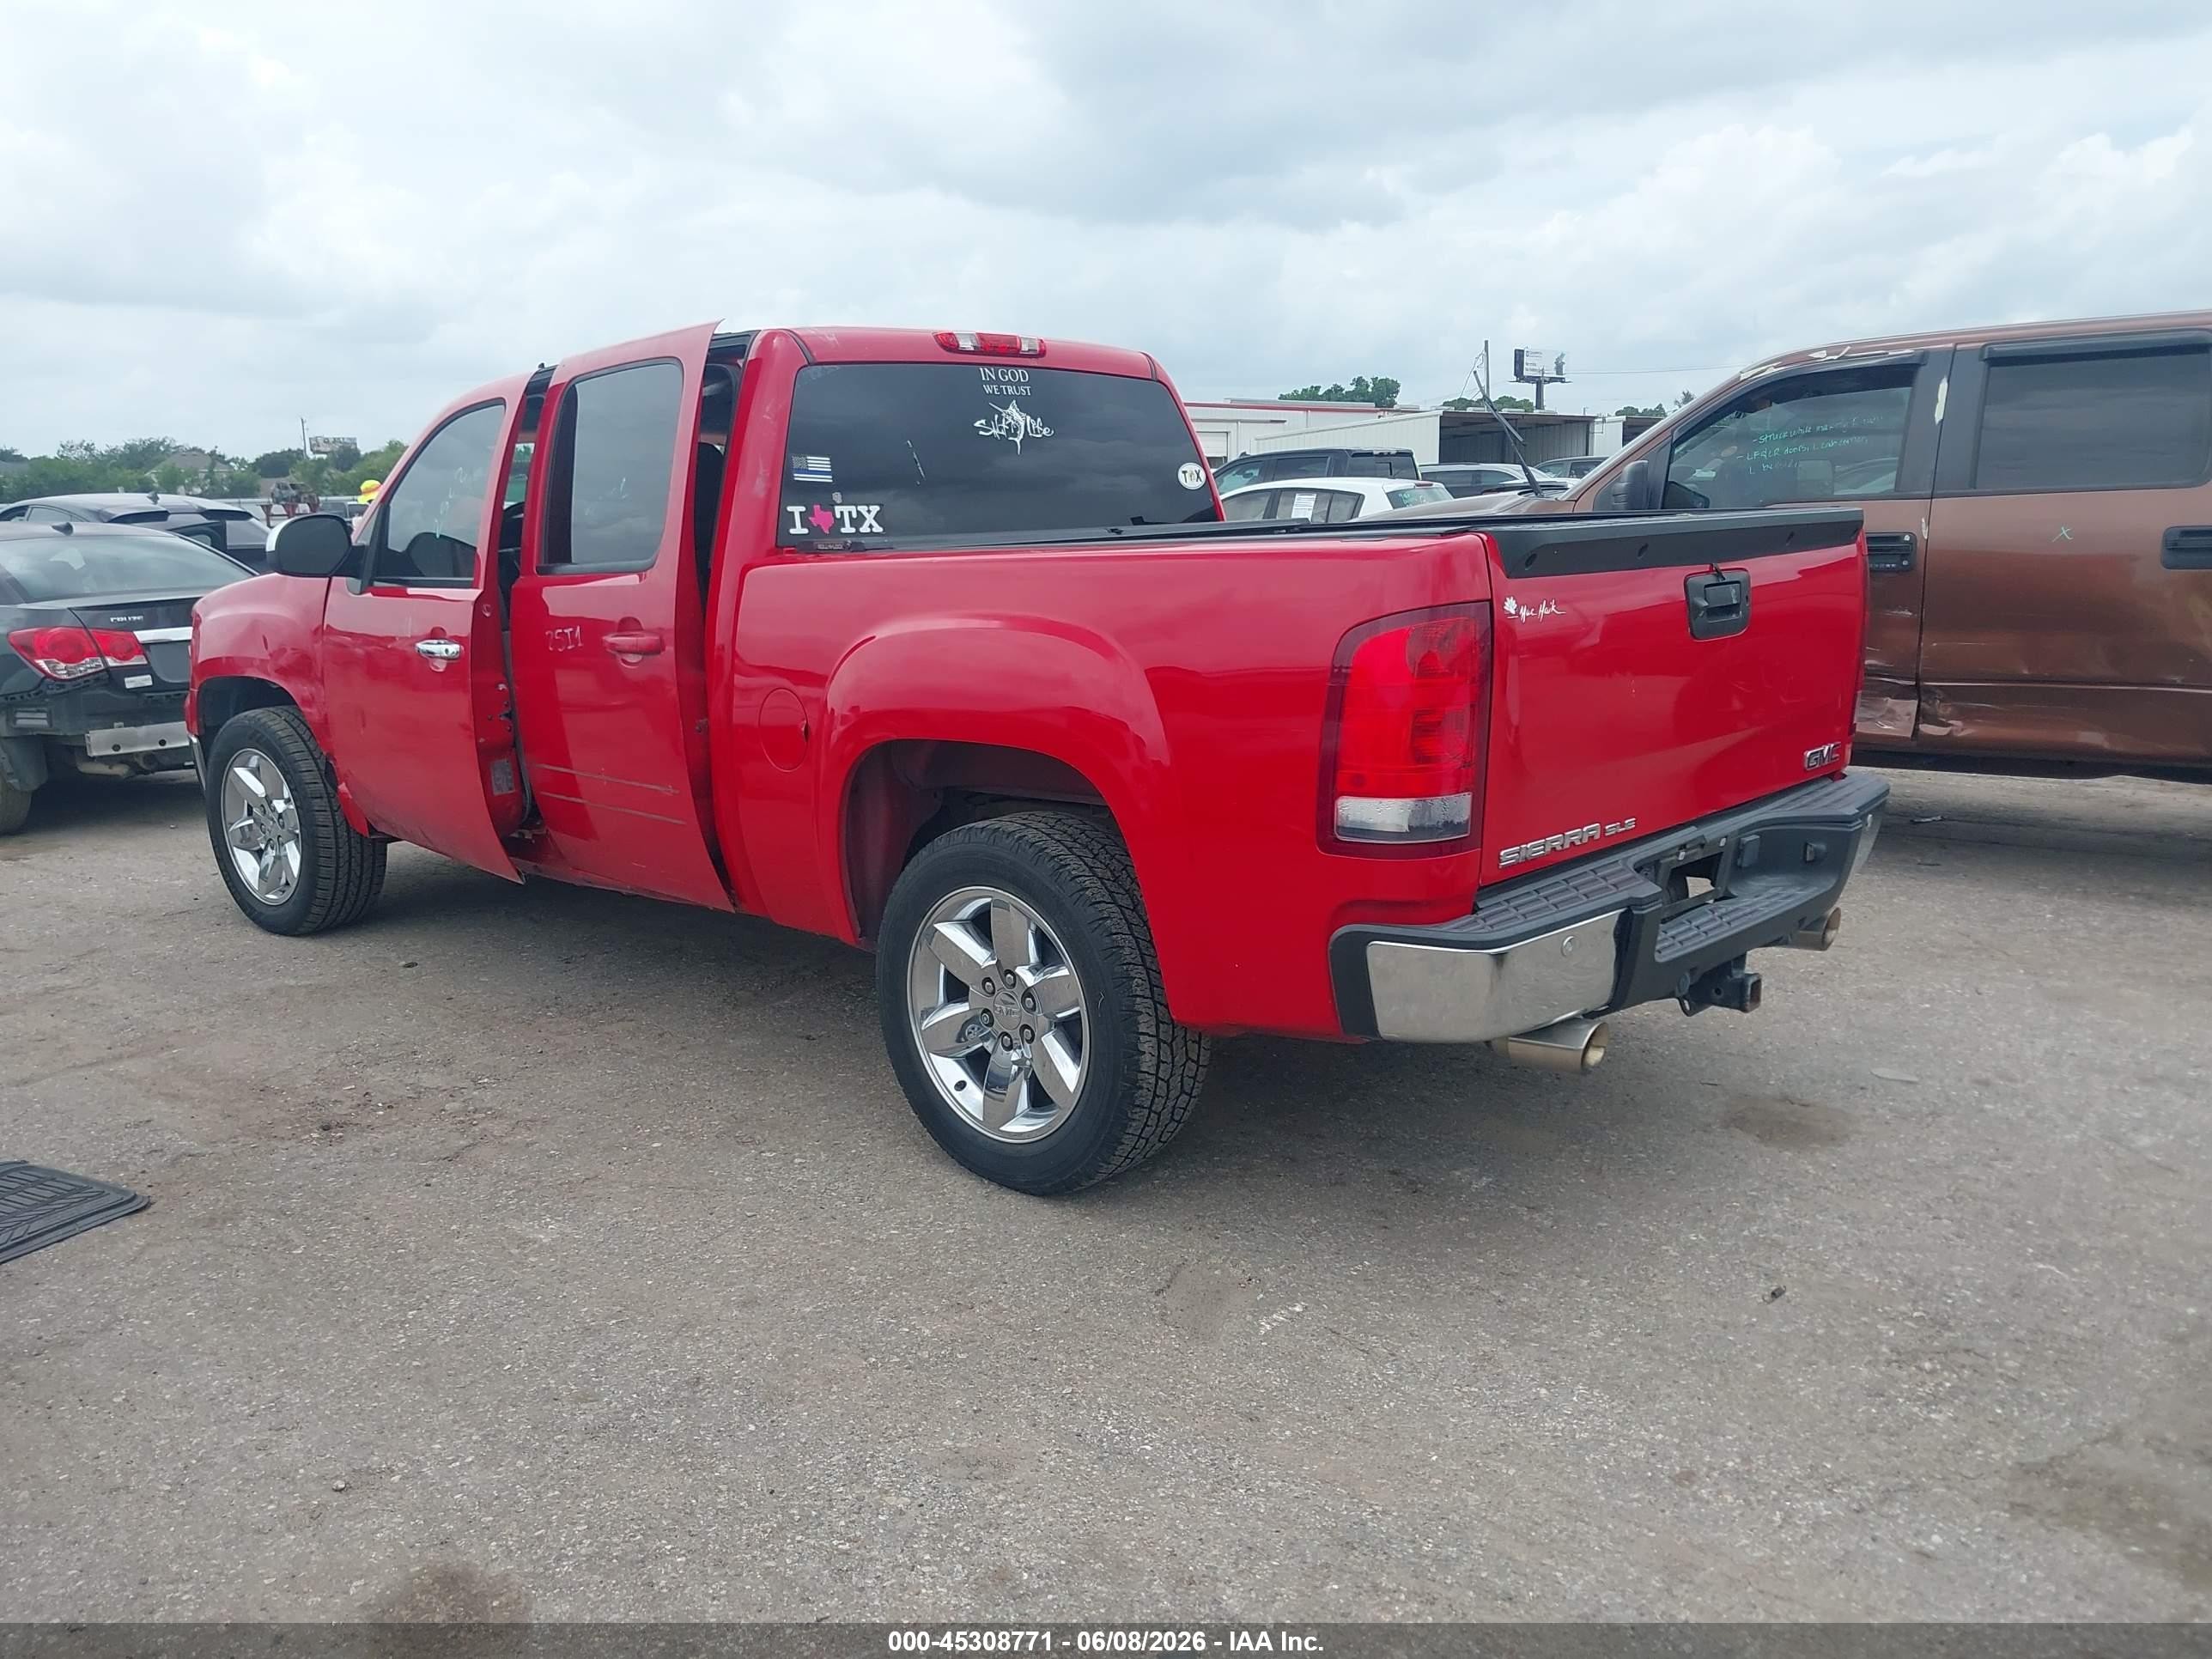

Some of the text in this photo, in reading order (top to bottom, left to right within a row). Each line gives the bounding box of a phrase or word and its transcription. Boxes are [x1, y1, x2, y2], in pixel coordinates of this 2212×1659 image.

[979, 368, 1030, 382] IN GOD
[982, 384, 1031, 396] WE TRUST
[786, 505, 884, 535] I TX
[1803, 741, 1842, 770] GMC
[1498, 817, 1637, 868] SIERRA SLE
